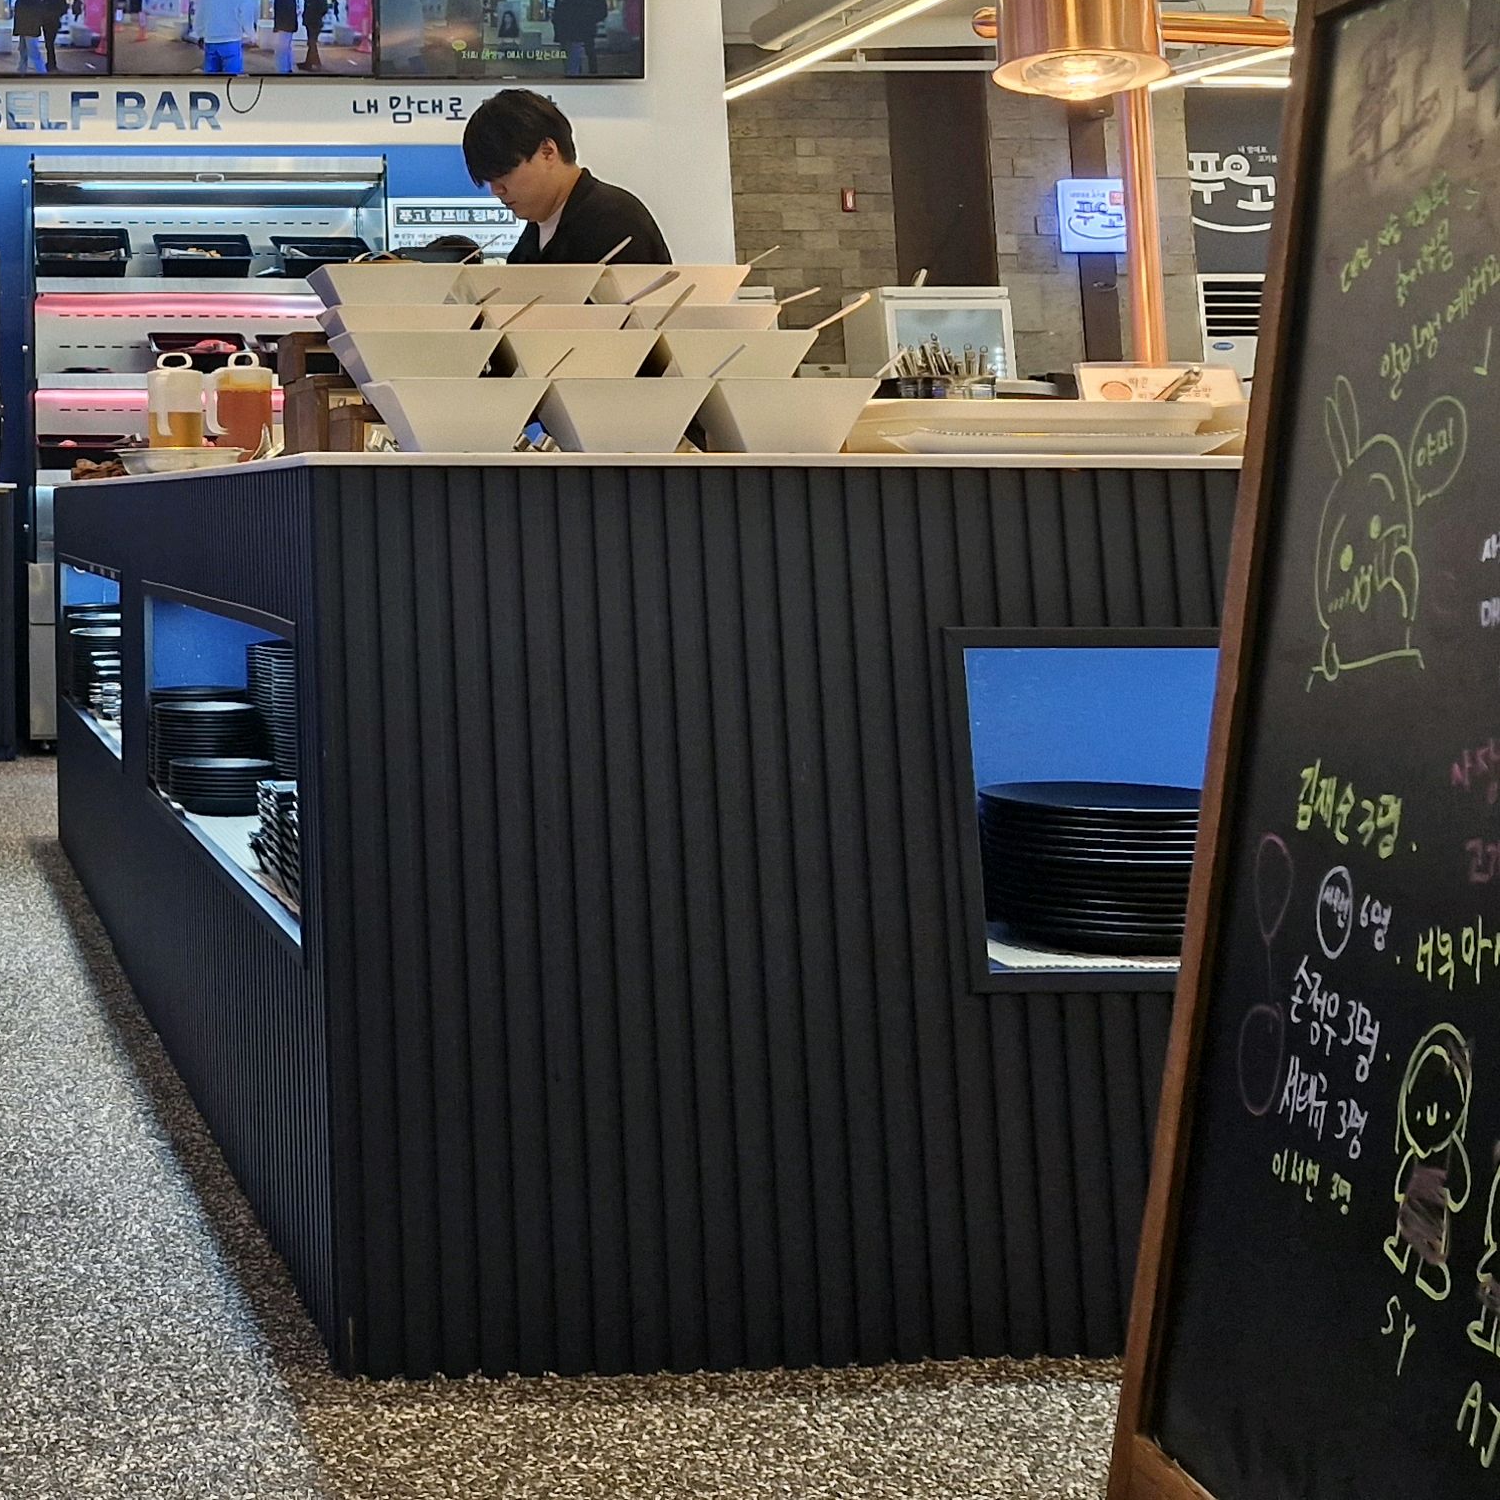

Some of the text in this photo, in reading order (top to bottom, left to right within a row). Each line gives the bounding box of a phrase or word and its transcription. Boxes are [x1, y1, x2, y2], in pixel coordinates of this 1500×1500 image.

[116, 91, 222, 131] BAR
[352, 99, 378, 115] 내
[389, 95, 467, 124] 맘대로
[1333, 1098, 1370, 1160] 3명
